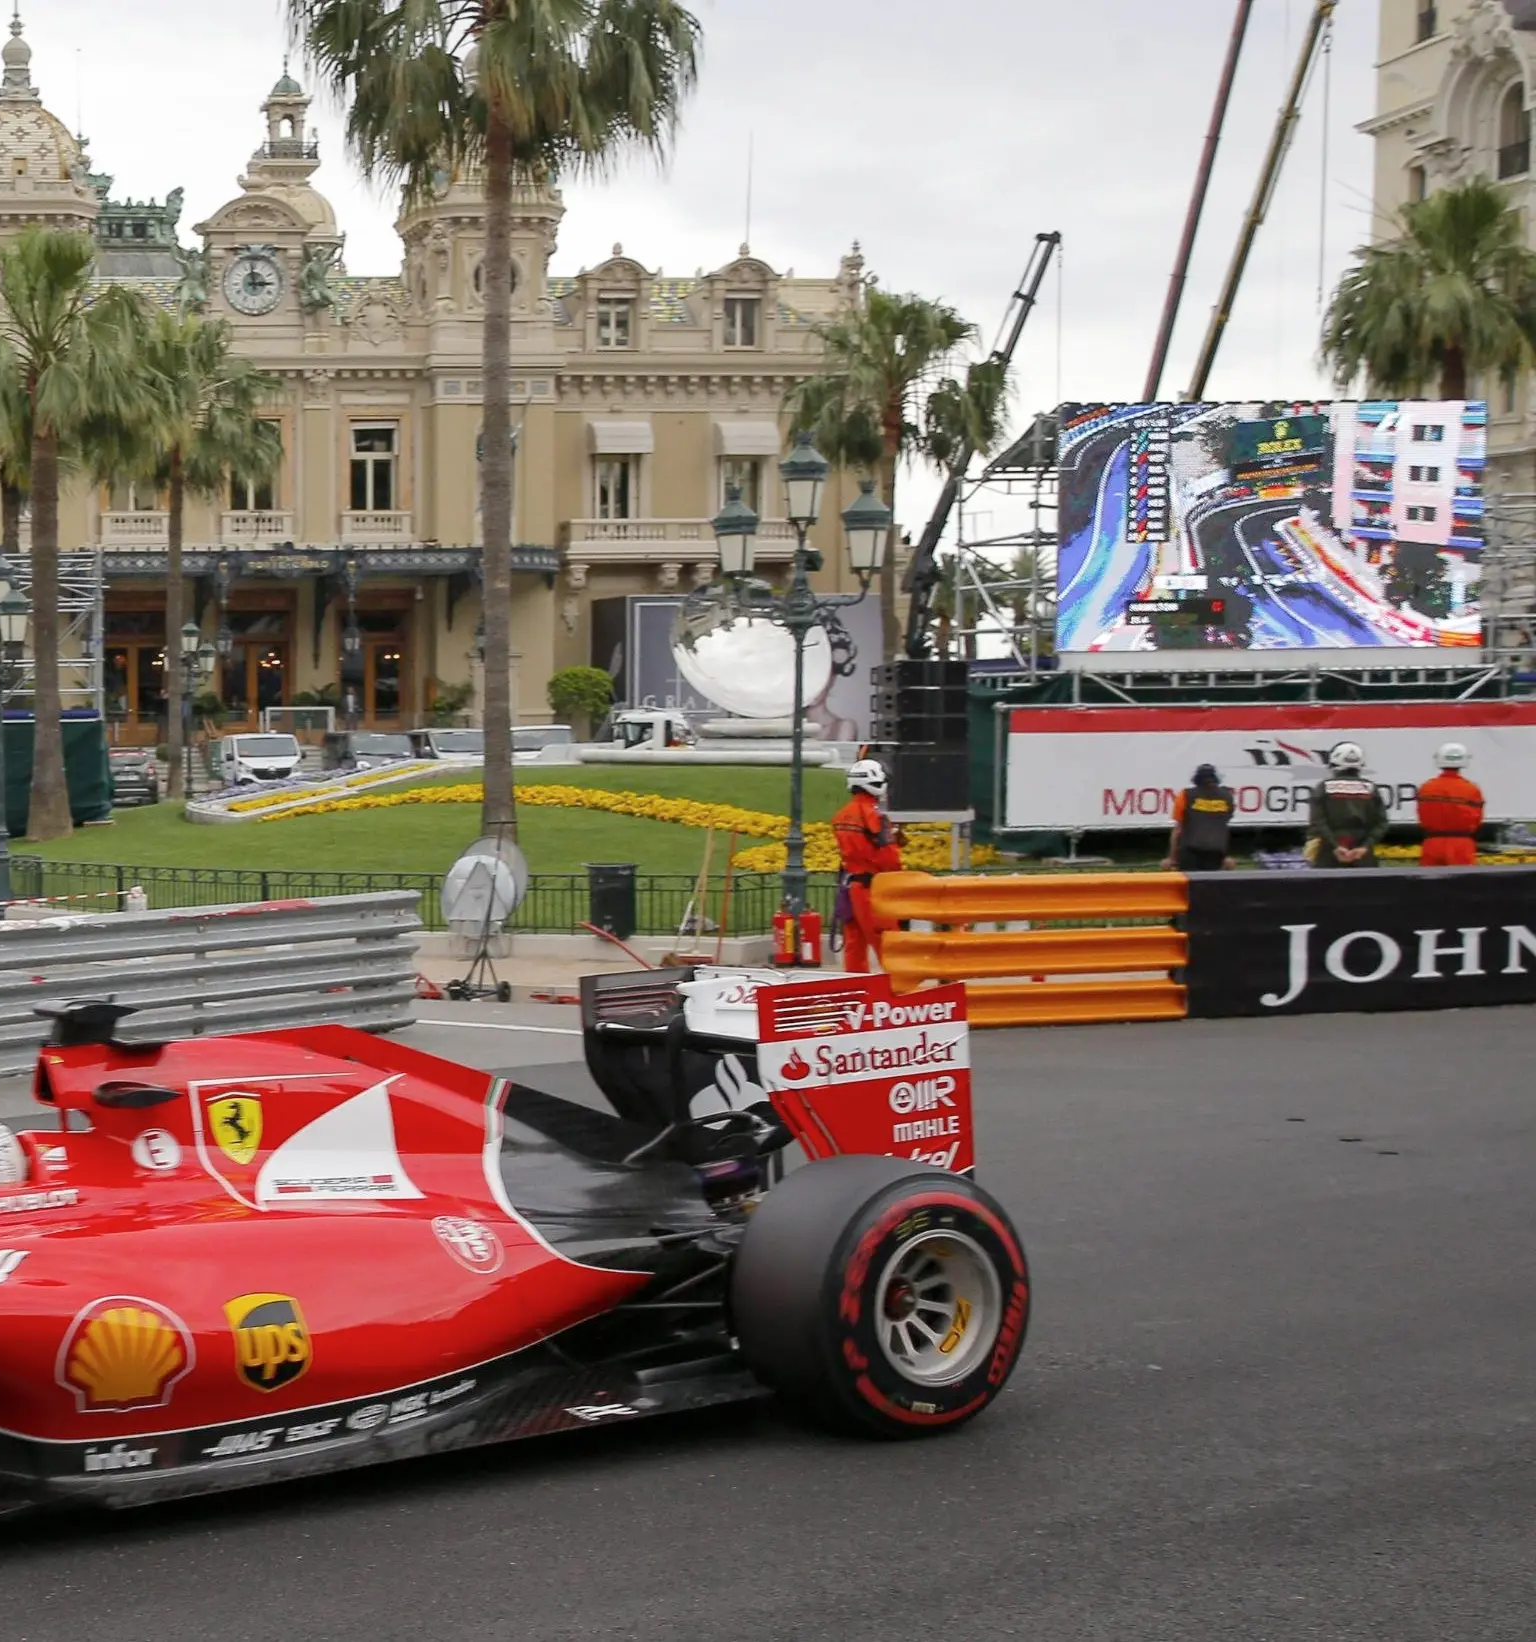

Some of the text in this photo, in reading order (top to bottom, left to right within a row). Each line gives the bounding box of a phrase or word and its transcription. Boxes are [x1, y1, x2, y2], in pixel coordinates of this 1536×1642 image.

[643, 695, 712, 709] GRA
[816, 1031, 957, 1077] Santander
[237, 1322, 309, 1380] ups
[84, 1443, 159, 1472] infor
